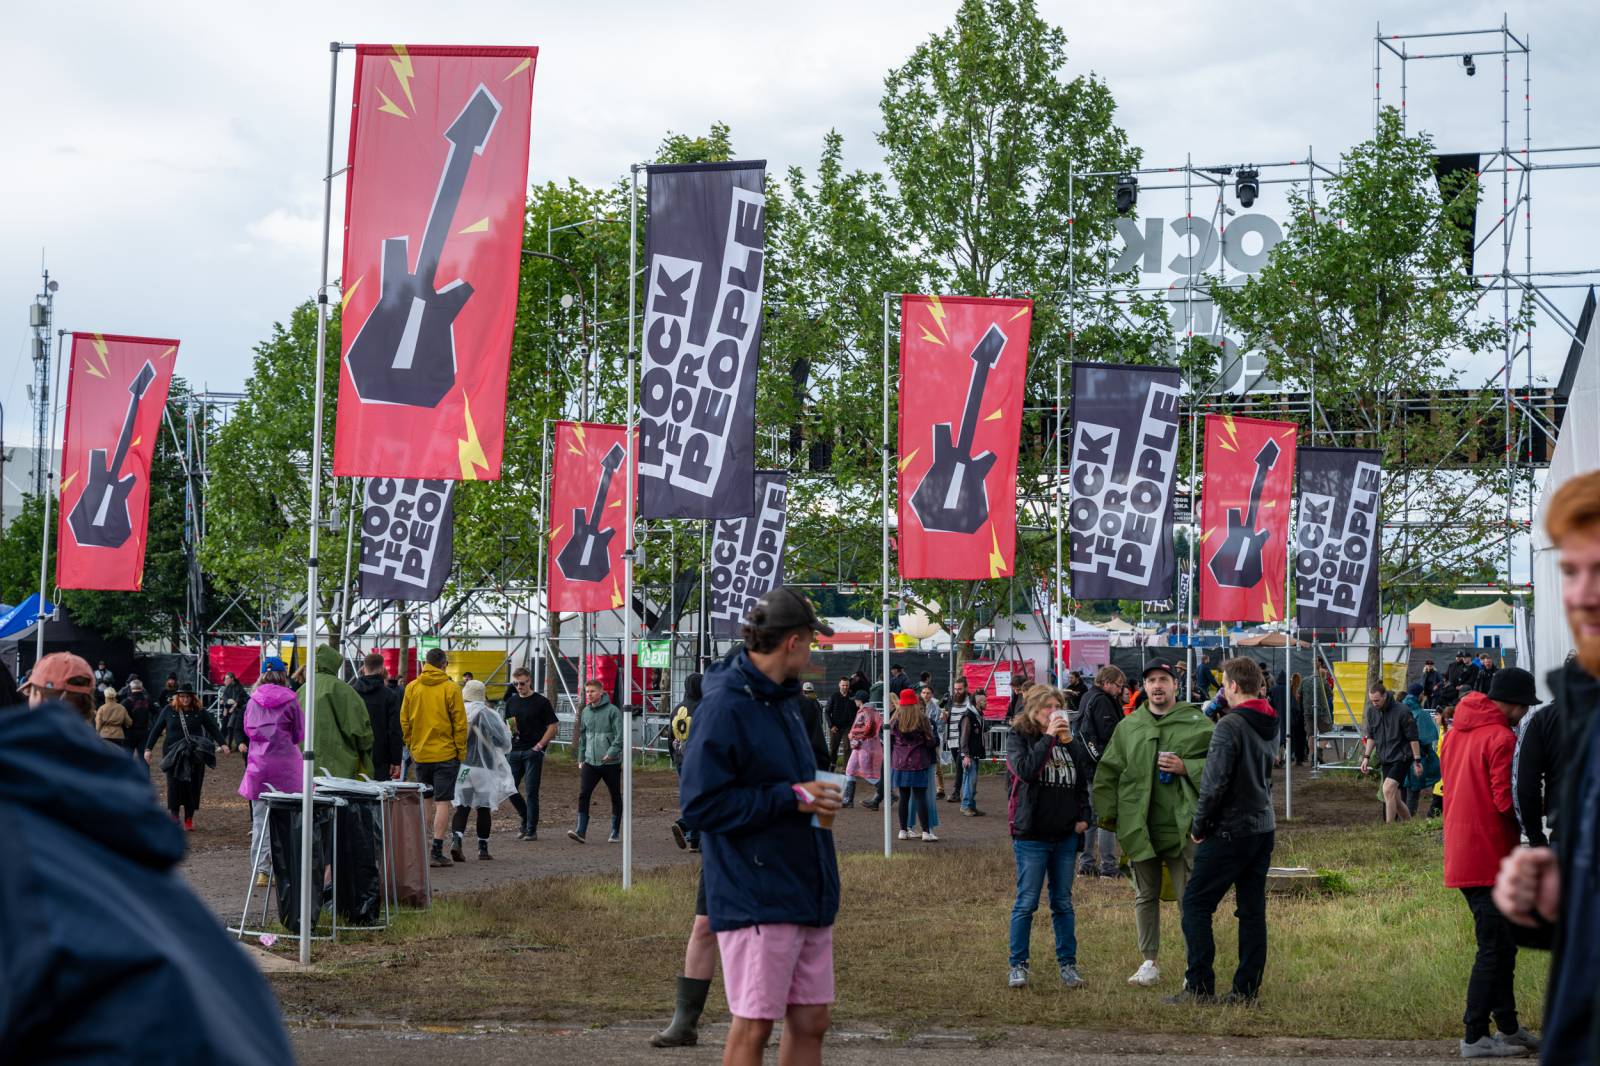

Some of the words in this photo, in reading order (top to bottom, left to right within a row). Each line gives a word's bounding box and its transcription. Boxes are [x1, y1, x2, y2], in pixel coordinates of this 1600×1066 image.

[640, 263, 694, 467] ROCK
[679, 199, 765, 484] PEOPLE
[664, 353, 704, 457] FOR
[361, 478, 397, 567] ROC
[384, 499, 415, 563] FOR
[401, 479, 448, 580] PEO
[1070, 428, 1113, 564] ROCK
[1095, 489, 1128, 558] FOR
[1115, 391, 1179, 578] PEOPLE
[711, 519, 742, 613] ROCK
[729, 559, 750, 609] FOR
[1296, 497, 1330, 601] ROCK
[1316, 543, 1342, 596] FOR
[1333, 468, 1380, 610] PEOPLE
